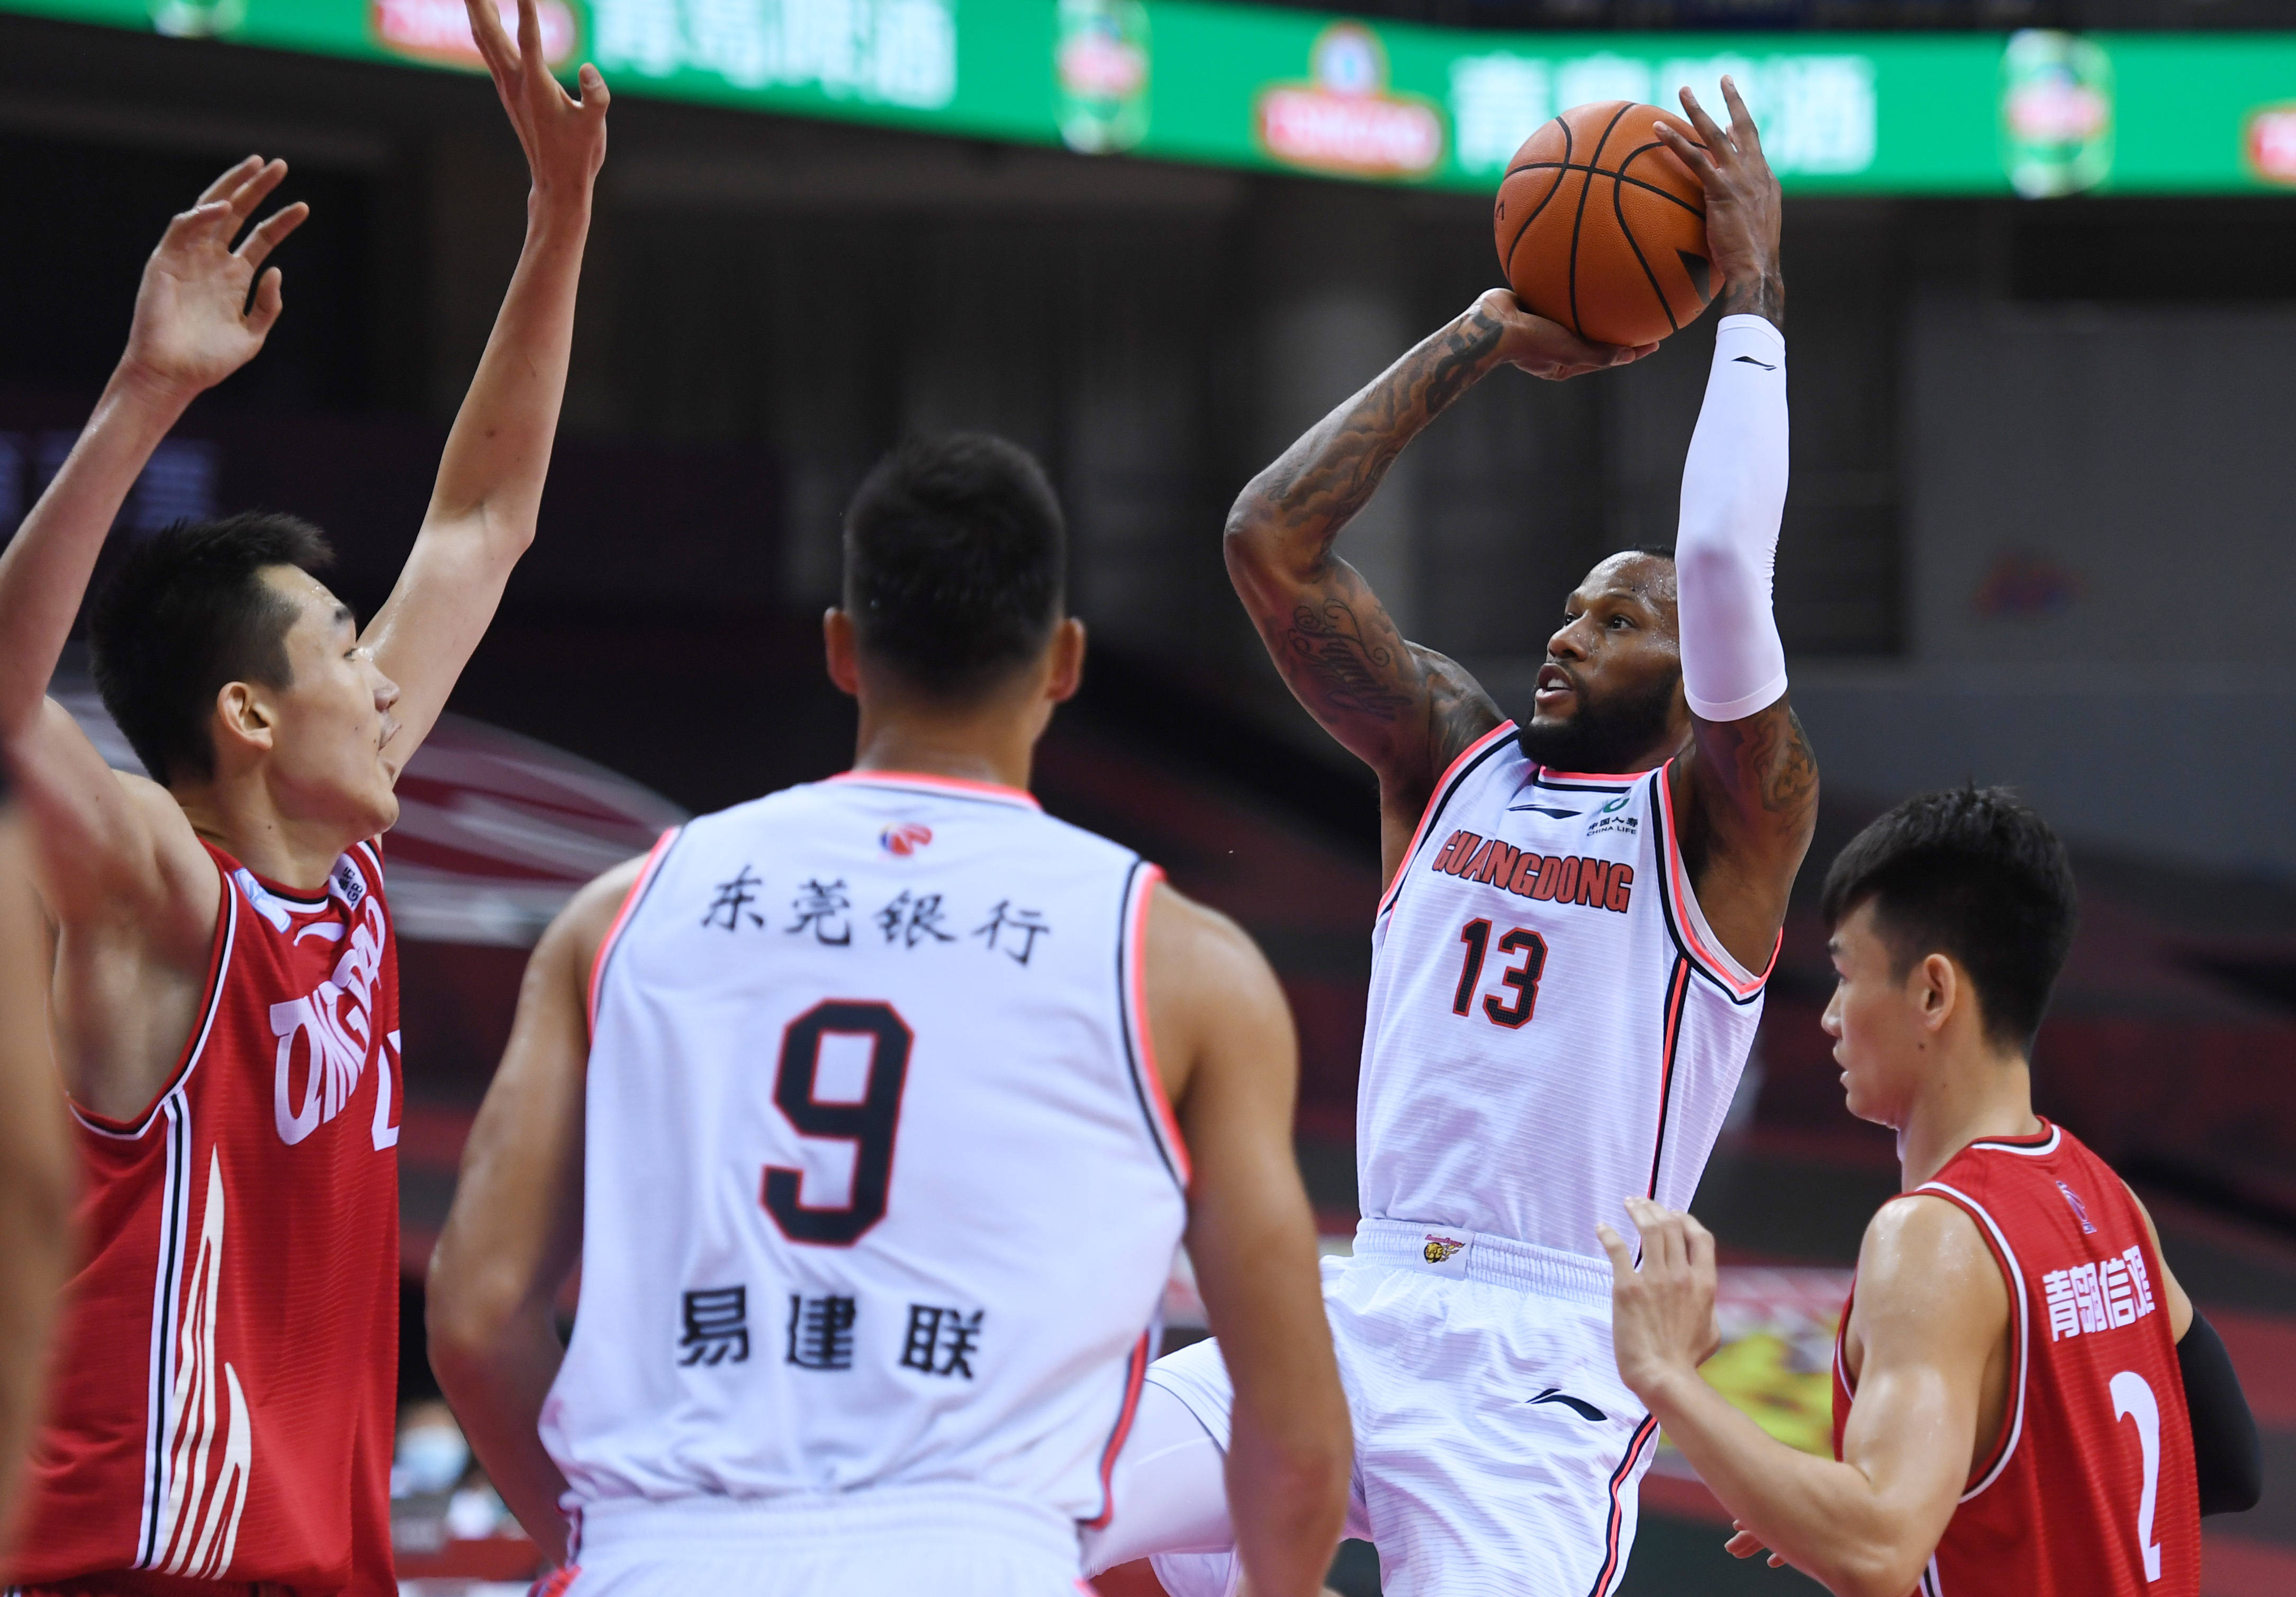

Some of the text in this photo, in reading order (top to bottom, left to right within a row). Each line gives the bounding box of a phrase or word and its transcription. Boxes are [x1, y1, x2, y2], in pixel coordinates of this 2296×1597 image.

[1432, 829, 1634, 914] GUANGDONG
[1587, 826, 1637, 836] CHINA LIFE
[1588, 816, 1638, 831] 中国人寿
[701, 864, 1050, 967] 东莞银行
[1452, 917, 1548, 1030] 13
[758, 997, 914, 1249] 9
[678, 1284, 985, 1381] 易建联
[2109, 1371, 2161, 1583] 2
